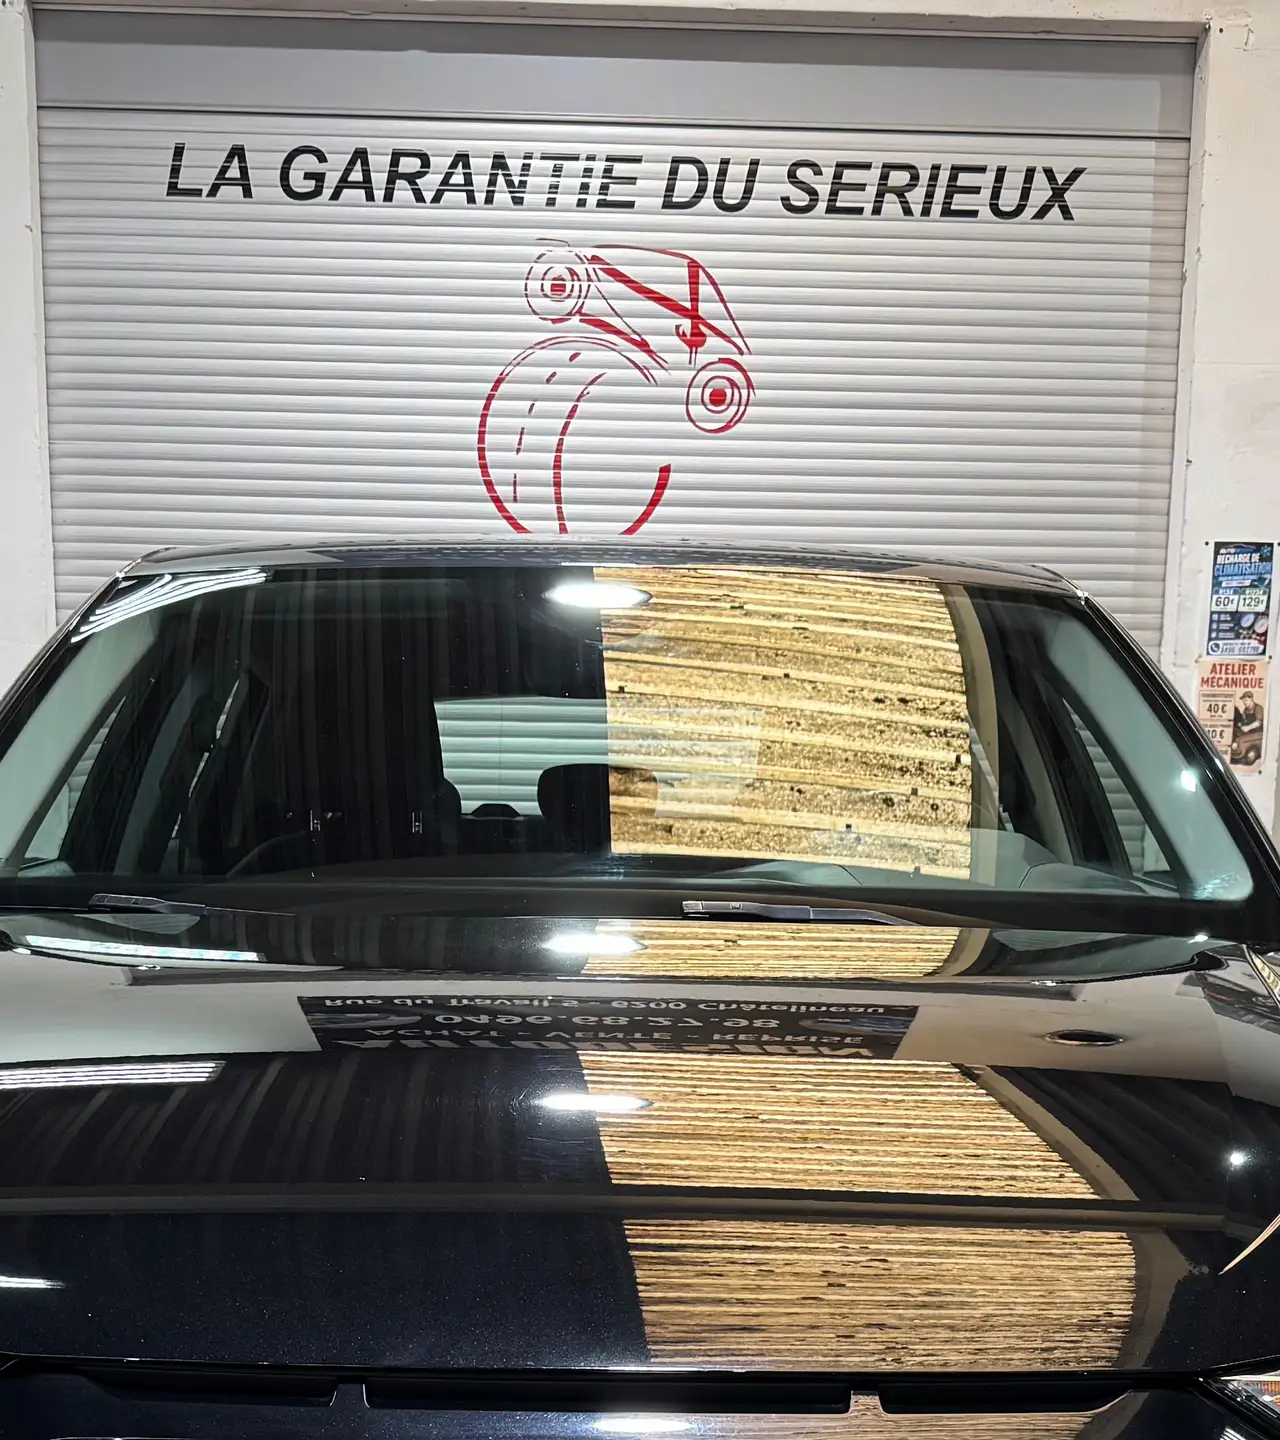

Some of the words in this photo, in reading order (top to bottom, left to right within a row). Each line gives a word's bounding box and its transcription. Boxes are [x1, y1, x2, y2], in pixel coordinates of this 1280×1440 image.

[165, 142, 254, 200] LA
[278, 146, 645, 211] GARANTIE
[660, 155, 761, 214] DU
[780, 160, 1089, 222] SERIEUX
[1210, 663, 1256, 675] ATELIER
[1201, 676, 1264, 688] MÉCANIQUE
